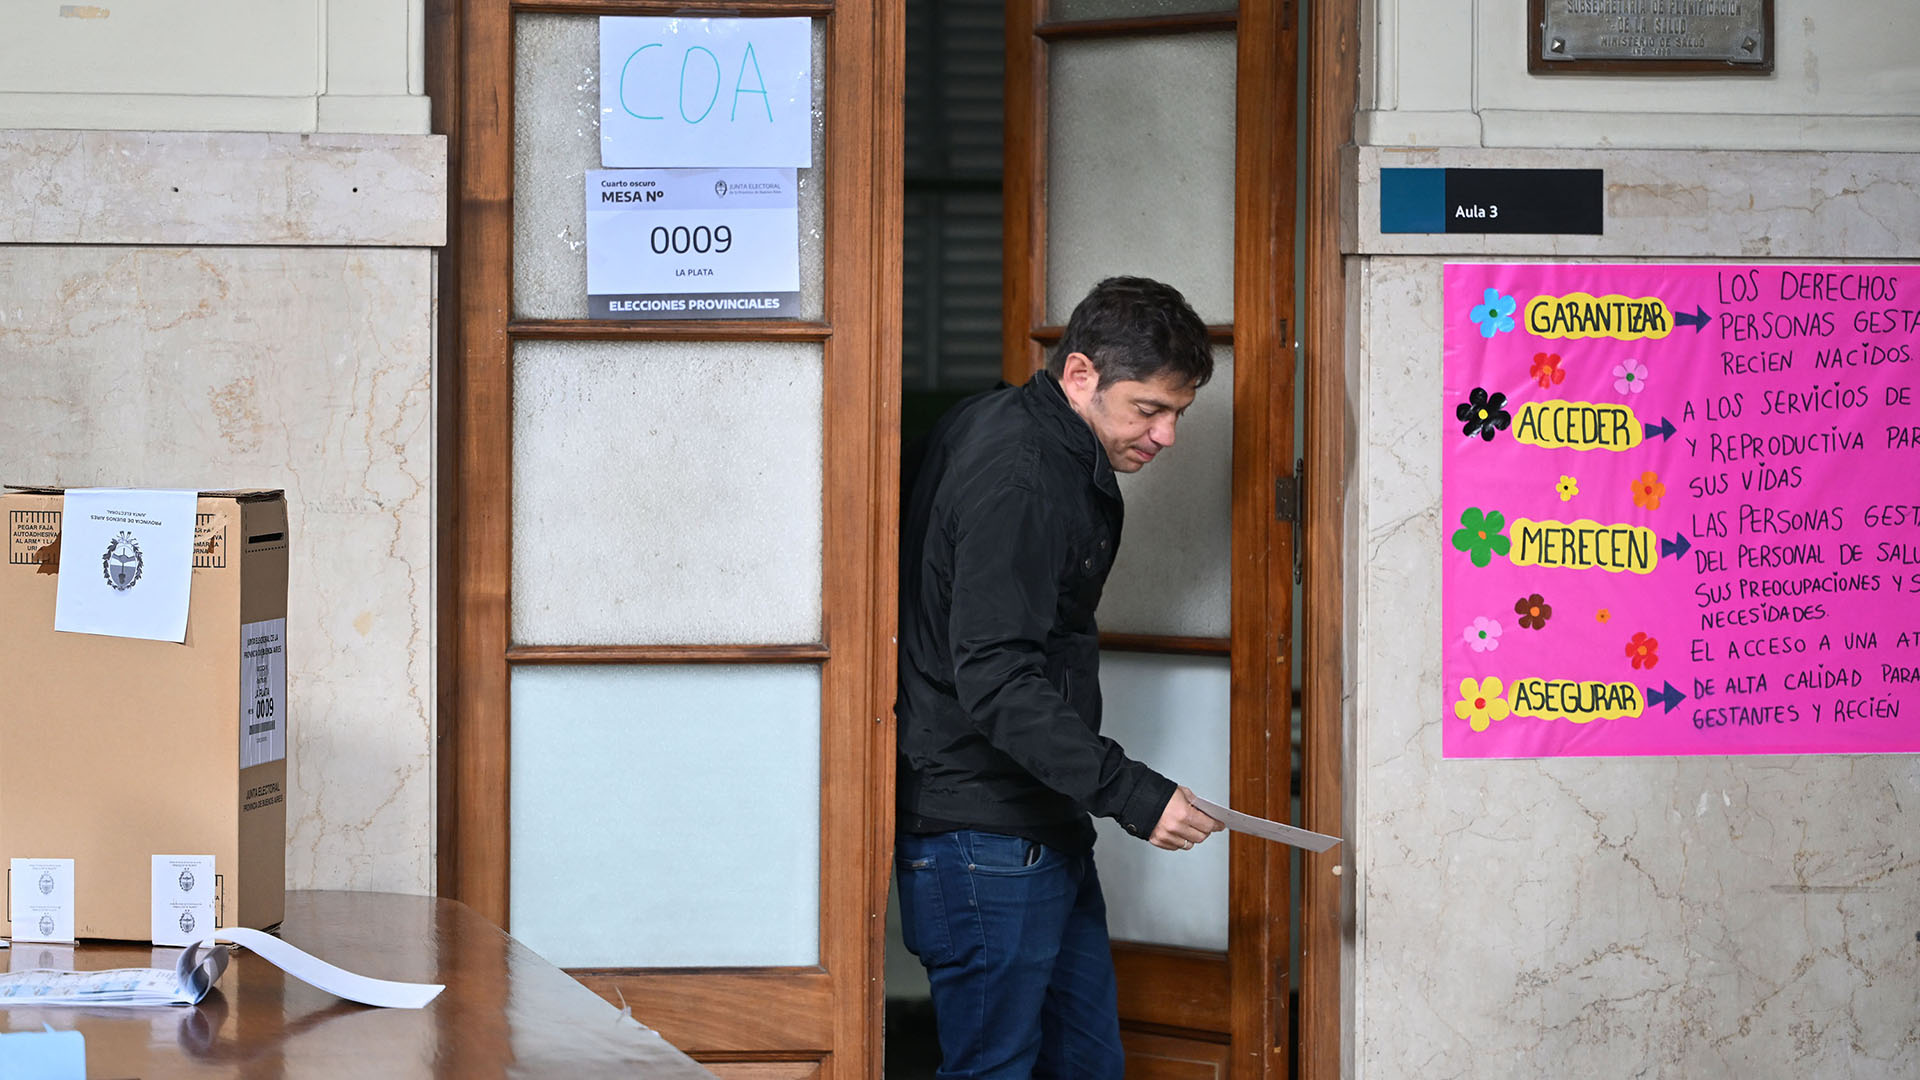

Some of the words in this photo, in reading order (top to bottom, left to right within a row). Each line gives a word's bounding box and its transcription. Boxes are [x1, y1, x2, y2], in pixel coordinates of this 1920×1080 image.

[1618, 17, 1629, 33] DE
[1635, 18, 1647, 33] LA
[1655, 18, 1687, 34] SALUD
[1601, 36, 1655, 47] MINISTERIO
[1660, 38, 1671, 47] DE
[1676, 38, 1705, 48] SALUD
[619, 41, 773, 124] COA
[601, 180, 628, 188] Cuarto
[602, 191, 642, 202] MESA
[1455, 204, 1486, 218] Aula
[1489, 205, 1498, 218] 3
[651, 225, 732, 254] 0009
[1718, 269, 1760, 304] LOS
[1780, 271, 1898, 301] DERECHOS
[609, 300, 686, 311] ELECCIONES
[689, 298, 780, 310] PROVINCIALES
[1719, 311, 1835, 341] PERSONAS
[1683, 400, 1696, 423] A
[1706, 392, 1744, 421] LOS
[1885, 386, 1911, 406] DE
[1517, 406, 1631, 446] ACCEDER
[1685, 437, 1697, 457] Y
[1689, 473, 1729, 498] SUS
[1692, 511, 1728, 538] LAS
[1738, 504, 1843, 535] PERSONAS
[1864, 505, 1920, 528] GEST
[1520, 526, 1649, 570] MERECEN
[1694, 549, 1728, 575] DEL
[1738, 544, 1825, 568] PERSONAL
[1839, 543, 1863, 566] DE
[1695, 582, 1732, 608] SUS
[1892, 575, 1903, 593] Y
[1690, 639, 1715, 662] EL
[1728, 636, 1806, 659] ACCESO
[1819, 634, 1831, 651] A
[1844, 631, 1877, 650] UNA
[1514, 681, 1637, 712] ASEGURAR
[1694, 677, 1716, 700] DE
[1726, 673, 1767, 694] ALTA
[1692, 705, 1800, 730] GESTANTES
[1812, 703, 1821, 723] Y
